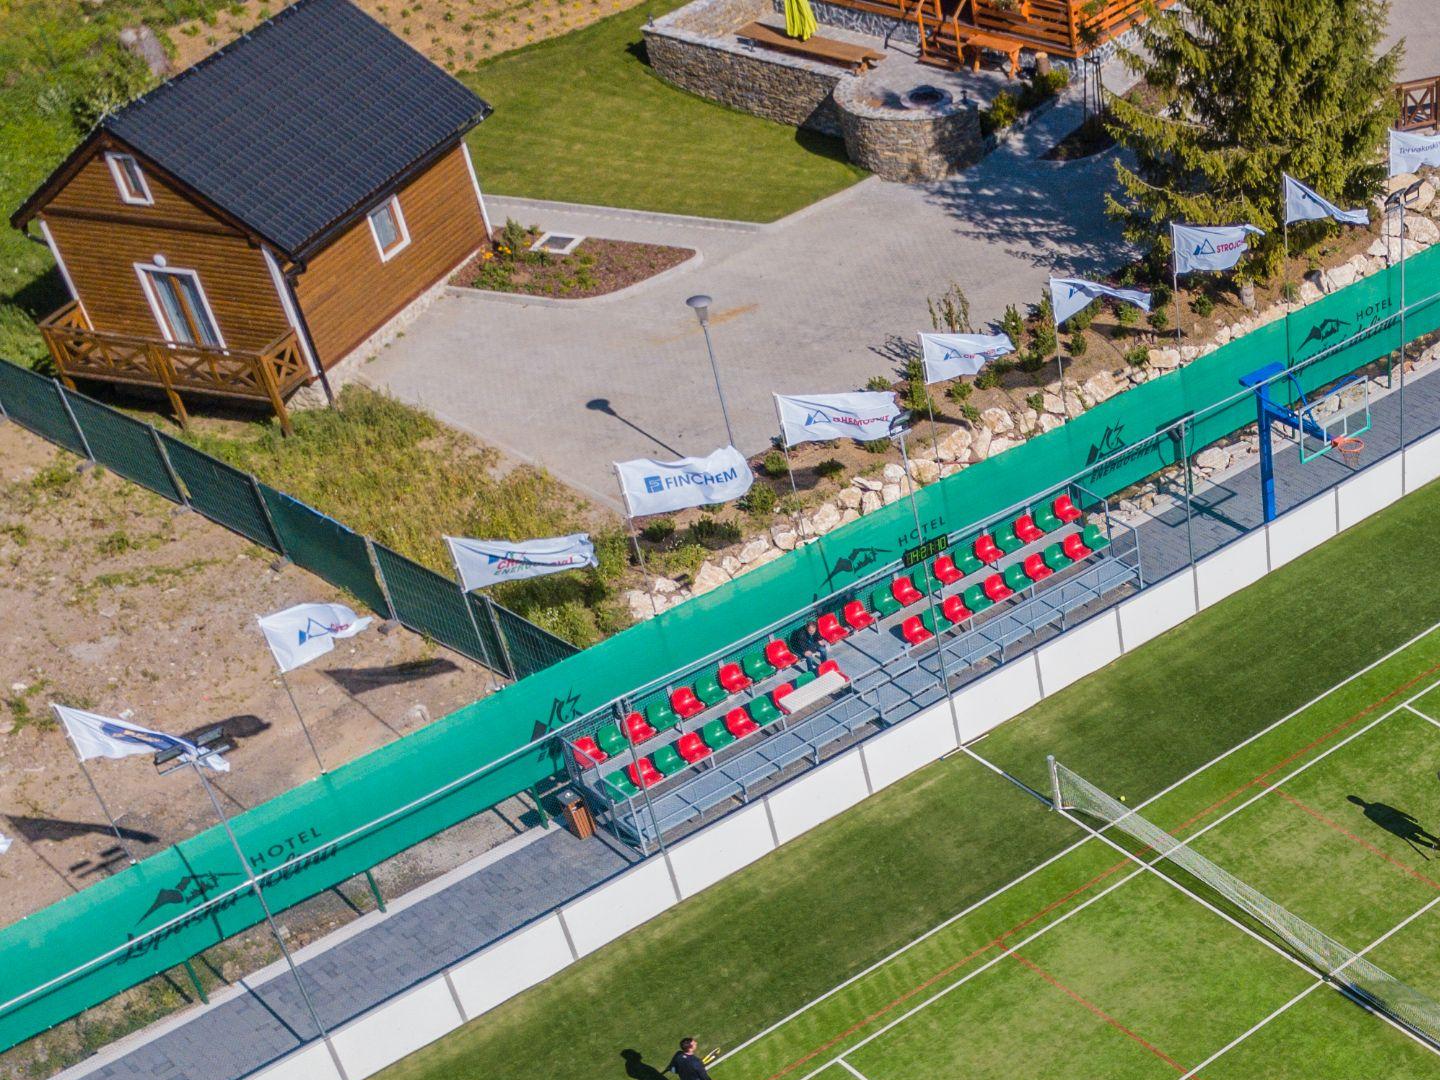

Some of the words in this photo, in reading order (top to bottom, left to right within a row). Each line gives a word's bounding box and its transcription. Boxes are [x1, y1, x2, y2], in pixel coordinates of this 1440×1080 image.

[1216, 239, 1246, 254] STROJC
[1356, 297, 1393, 321] HOTEL
[665, 467, 738, 490] FINCHEM
[250, 826, 322, 868] HOTEL
